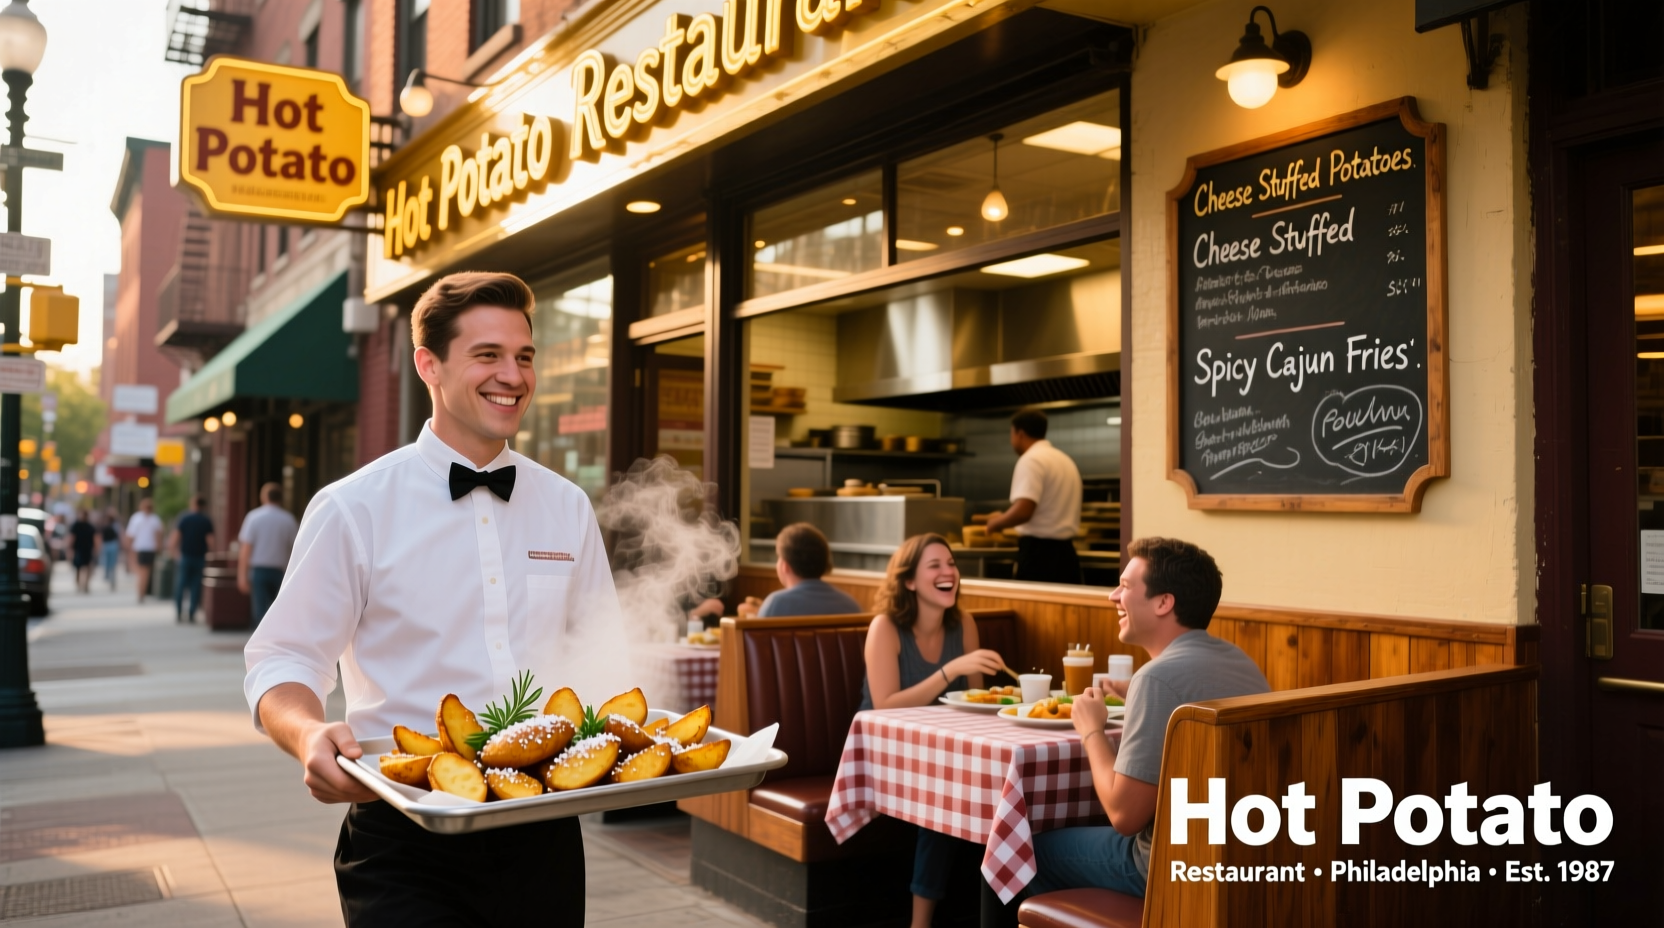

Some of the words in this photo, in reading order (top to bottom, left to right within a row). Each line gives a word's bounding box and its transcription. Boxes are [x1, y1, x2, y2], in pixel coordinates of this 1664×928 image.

[230, 79, 324, 133] Hot
[196, 126, 356, 187] Potato
[384, 175, 433, 259] Hot
[438, 112, 553, 231] Potato
[1194, 180, 1252, 217] Cheese
[1258, 157, 1320, 201] Stuffed
[1193, 230, 1261, 268] Cheese
[1269, 206, 1355, 257] Stuffed
[1194, 348, 1257, 397] Spicy
[1266, 342, 1334, 392] Cajun
